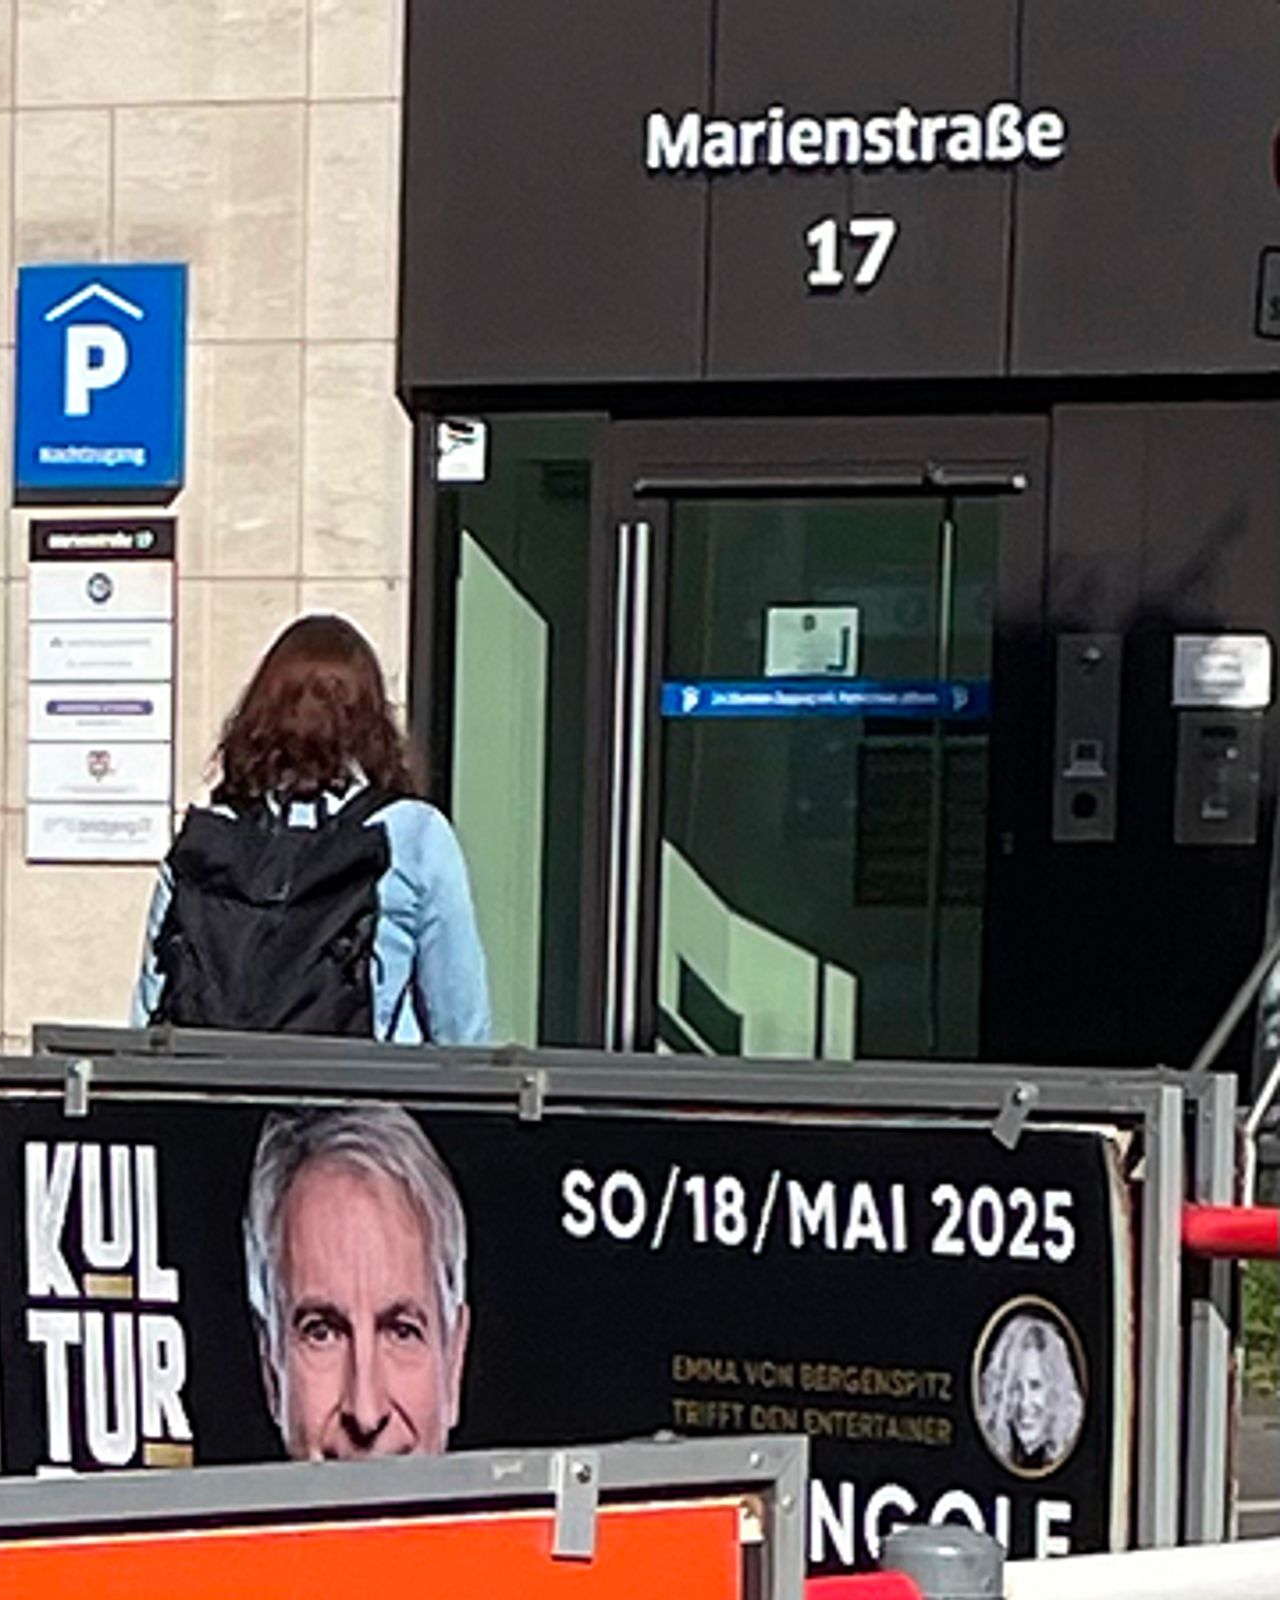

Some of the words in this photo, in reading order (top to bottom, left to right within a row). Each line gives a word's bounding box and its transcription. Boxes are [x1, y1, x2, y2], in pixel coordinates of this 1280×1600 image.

[646, 103, 1065, 169] Marienstraße
[806, 218, 897, 286] 17
[65, 323, 130, 418] P
[25, 1141, 179, 1303] KUL
[561, 1165, 908, 1254] SO/18/MAI
[930, 1183, 1076, 1262] 2025
[26, 1308, 194, 1467] TUR
[672, 1355, 739, 1383] EMMA
[743, 1361, 794, 1388] VON
[800, 1363, 953, 1400] BERGENSPITZ
[672, 1399, 744, 1427] TRIFFT
[750, 1405, 798, 1430] DEN
[803, 1407, 953, 1445] ENTERTAINER
